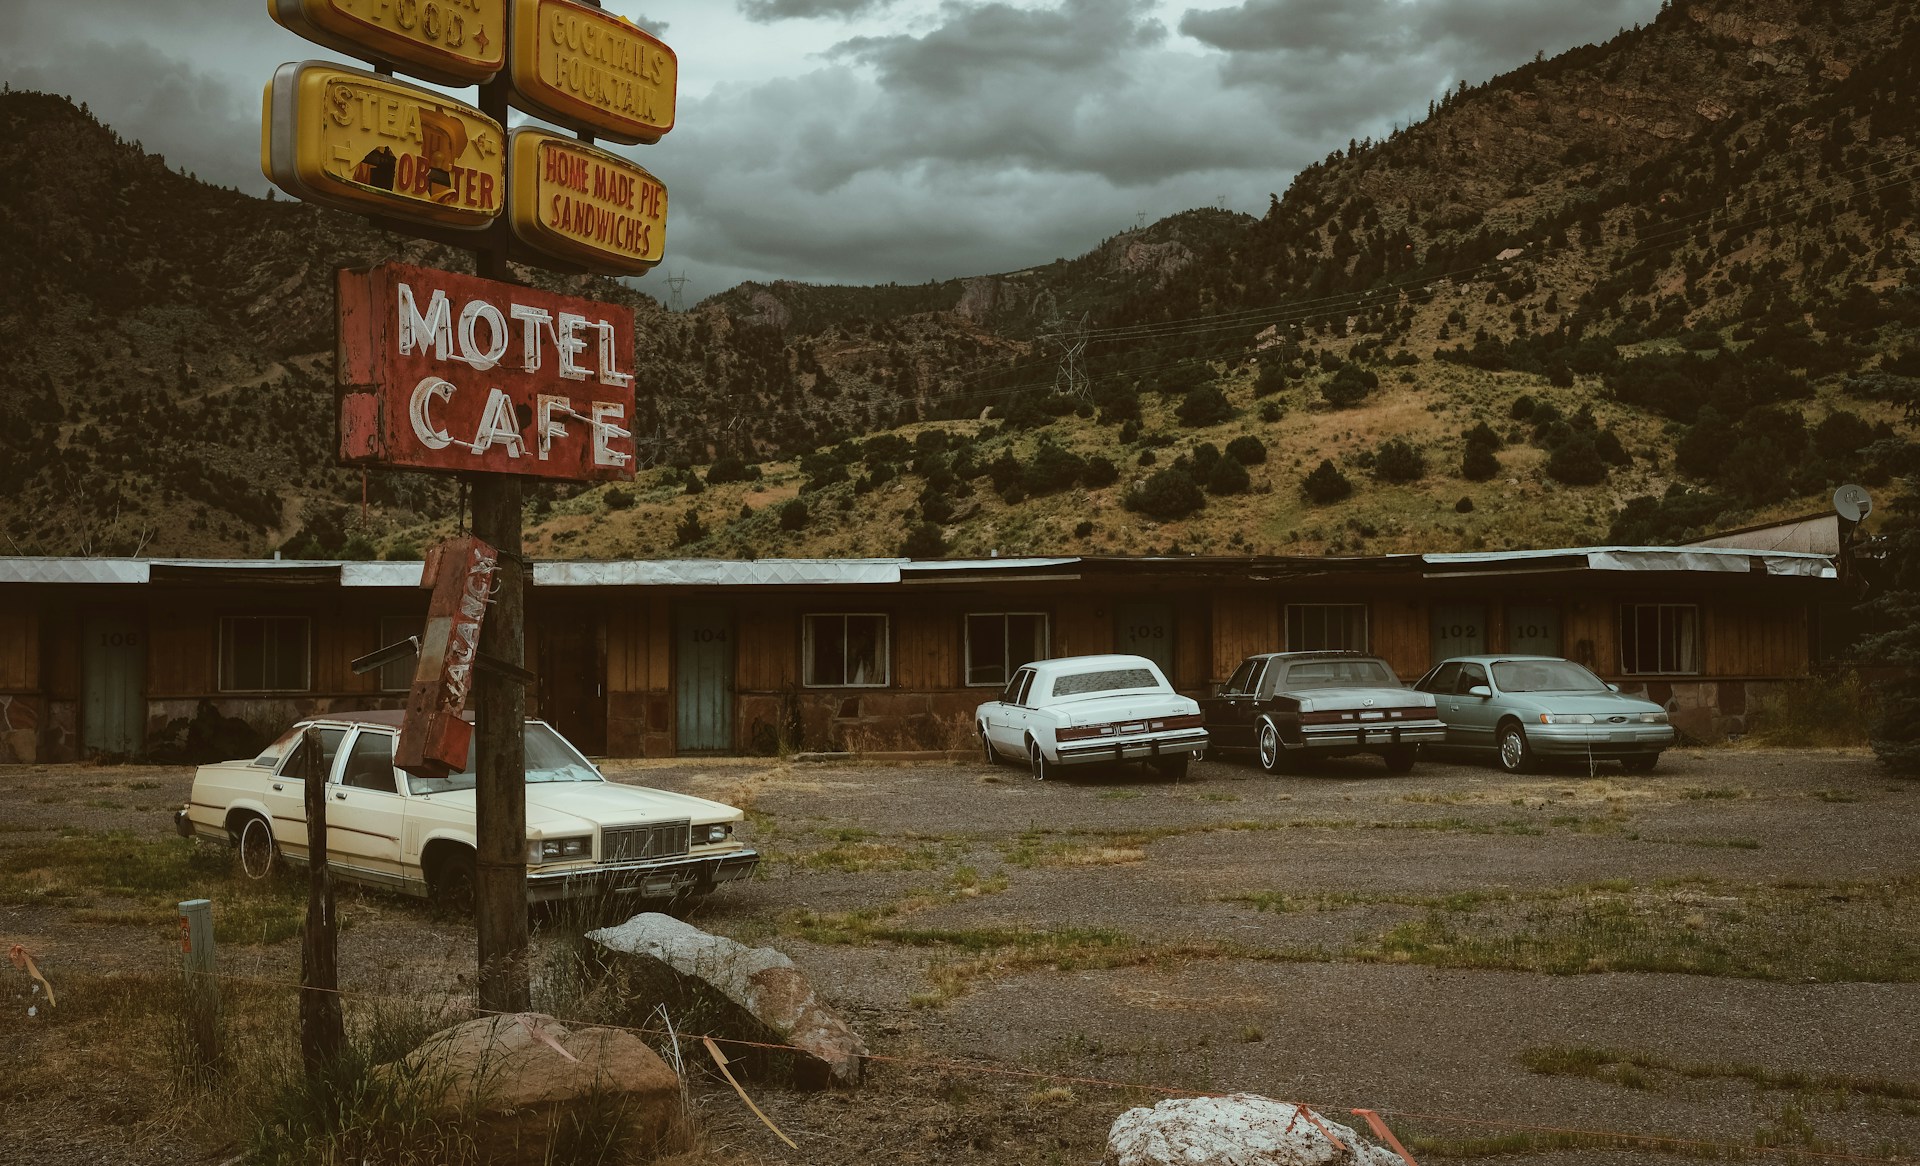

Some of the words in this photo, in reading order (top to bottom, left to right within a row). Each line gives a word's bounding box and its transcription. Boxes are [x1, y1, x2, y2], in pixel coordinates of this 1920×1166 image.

[552, 10, 664, 85] COCKTAILS
[331, 85, 424, 145] STEA
[555, 52, 657, 122] FOUNTAIN
[397, 152, 494, 209] OBTER
[544, 147, 589, 195] HOME
[593, 164, 635, 211] MADE
[639, 182, 662, 220] PIE
[550, 194, 651, 256] SANDWICHES
[398, 283, 633, 388] MOTEL
[409, 376, 632, 467] CAFE
[692, 628, 728, 643] 104
[1441, 624, 1476, 639] 102
[1517, 624, 1549, 639] 101
